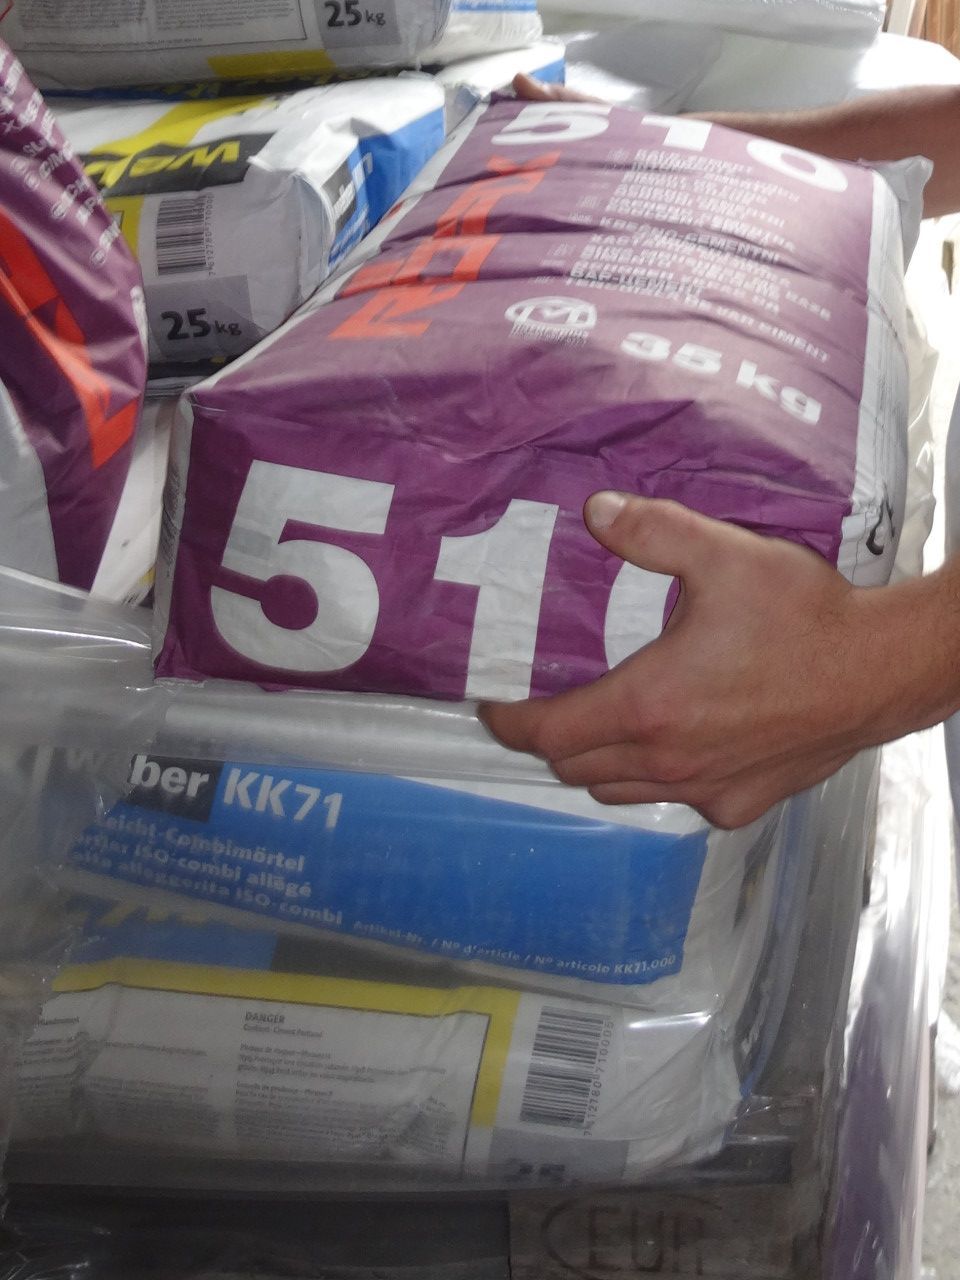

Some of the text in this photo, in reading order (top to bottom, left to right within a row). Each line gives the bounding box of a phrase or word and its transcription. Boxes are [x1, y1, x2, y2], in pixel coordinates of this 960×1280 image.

[365, 9, 386, 26] kg
[491, 101, 848, 193] 510
[161, 307, 242, 340] 25 kg
[619, 331, 723, 376] 35
[736, 358, 823, 425] kg
[223, 766, 343, 829] KK71
[102, 812, 305, 873] eicht-Combimörtel
[613, 954, 677, 976] KK71.000
